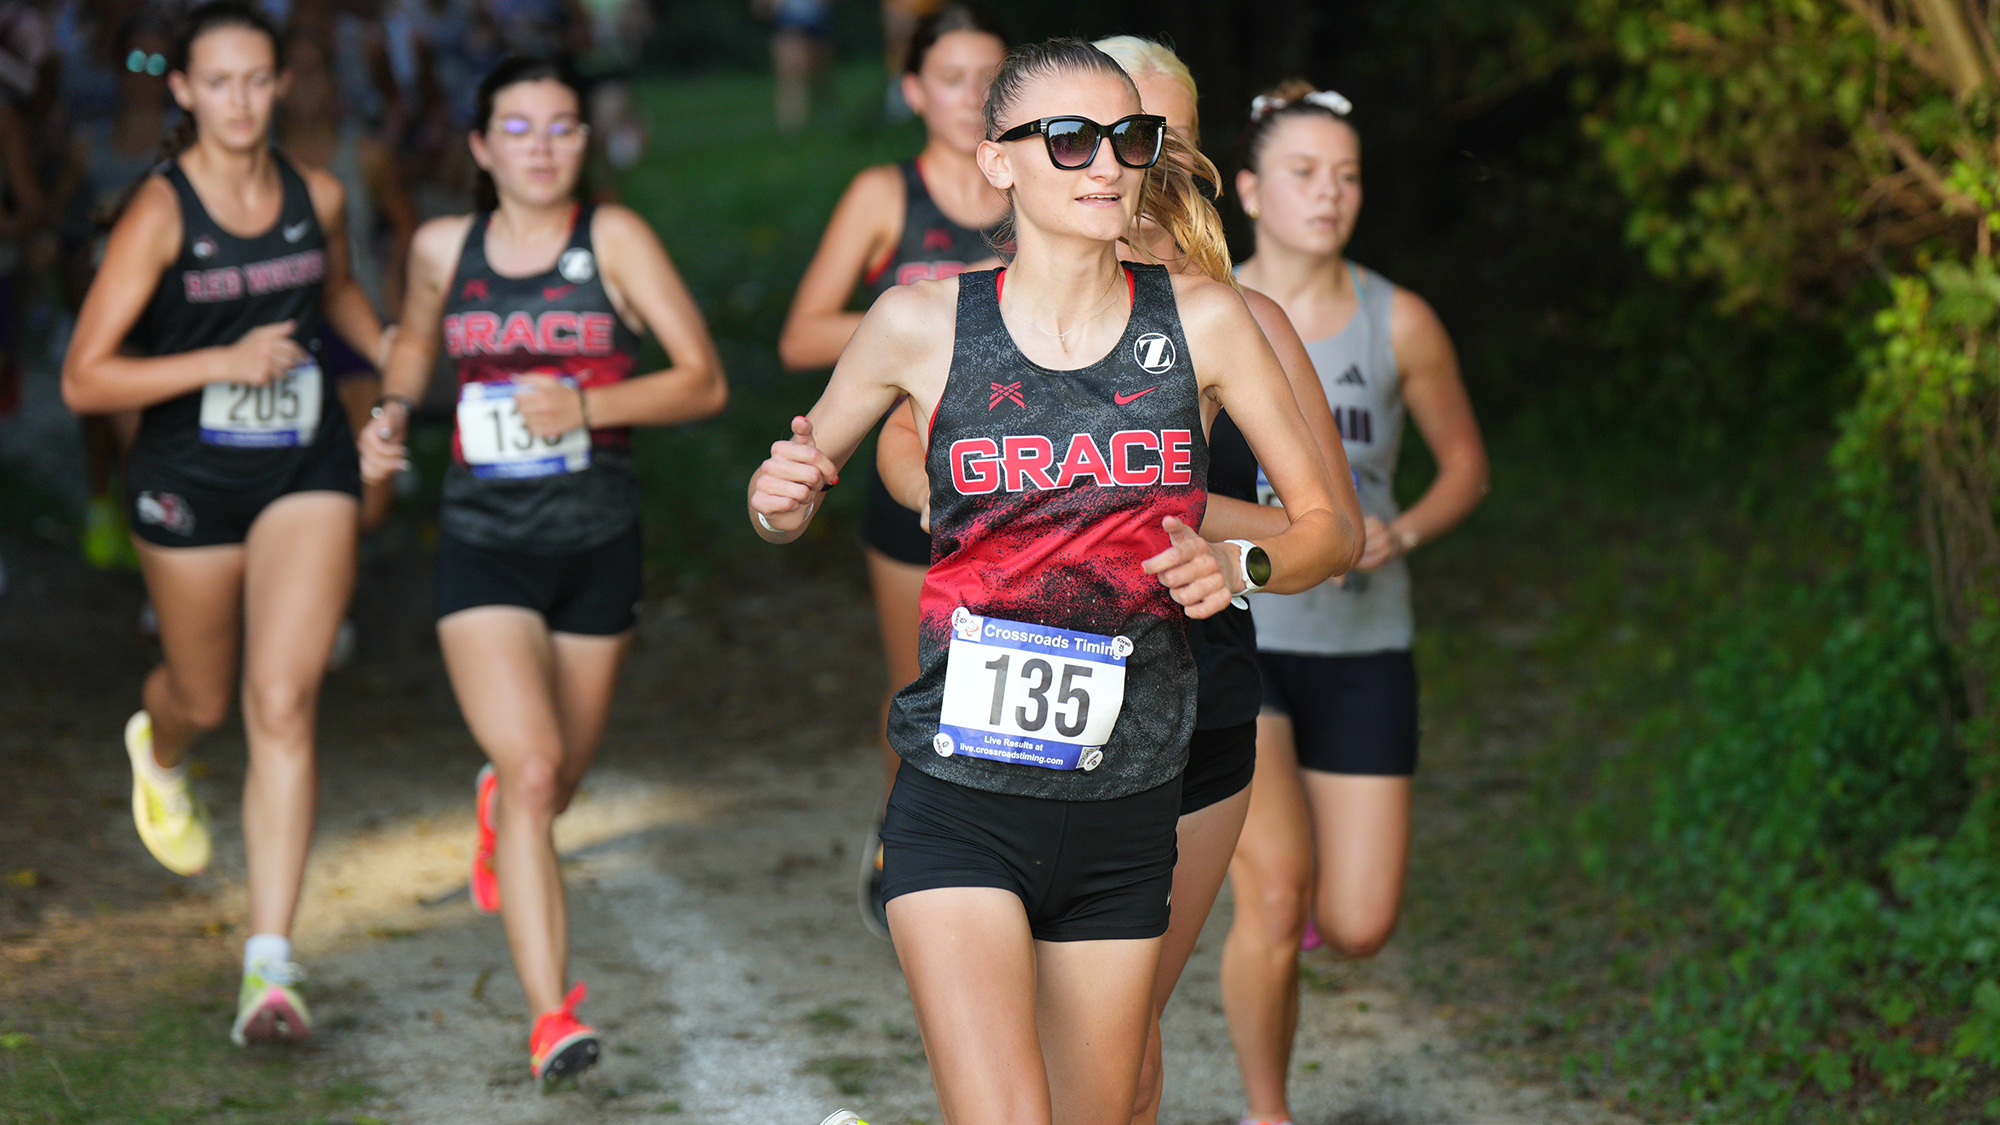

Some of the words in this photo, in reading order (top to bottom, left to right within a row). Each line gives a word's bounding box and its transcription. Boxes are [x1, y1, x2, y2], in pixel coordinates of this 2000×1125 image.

[183, 266, 244, 304] RED
[1138, 337, 1171, 369] Z
[228, 377, 299, 421] 205
[950, 429, 1192, 496] GRACE
[984, 623, 1069, 649] Crossroads
[984, 654, 1093, 738] 135
[959, 743, 1064, 766] live.crossroadstiming.com
[984, 735, 1002, 746] Live
[1003, 738, 1034, 750] Results
[1034, 743, 1044, 752] at
